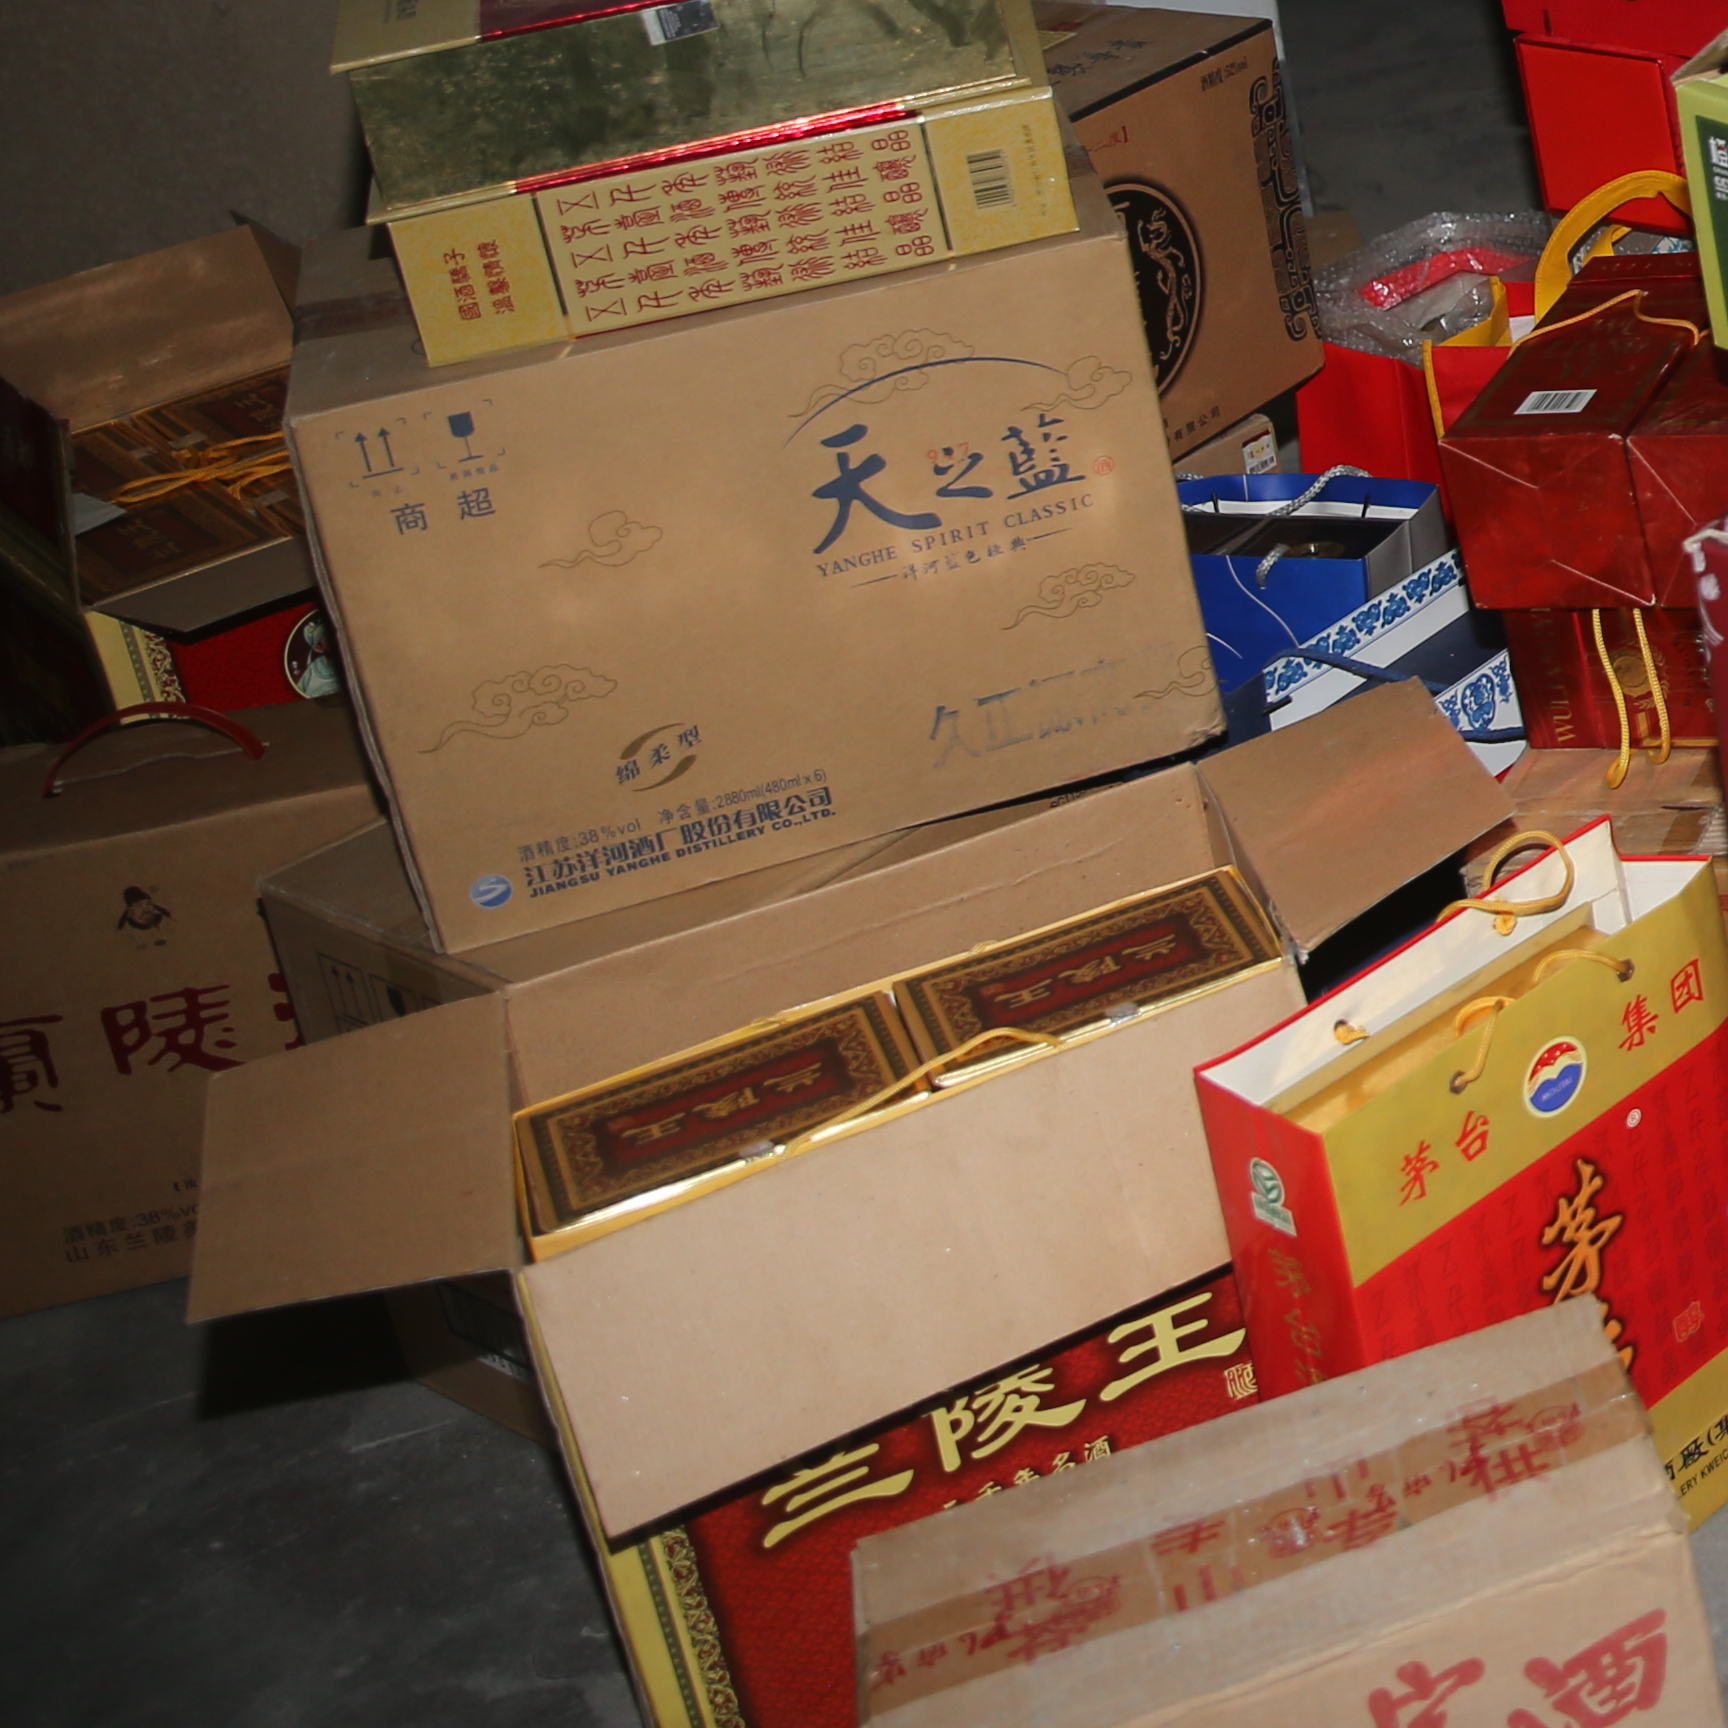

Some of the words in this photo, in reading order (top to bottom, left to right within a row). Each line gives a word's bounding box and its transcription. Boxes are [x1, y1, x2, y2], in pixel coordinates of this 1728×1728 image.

[1168, 405, 1221, 442] 有限公司
[390, 487, 497, 535] 商超
[817, 545, 897, 576] YANGHE
[911, 521, 990, 553] SPIRIT
[1003, 494, 1094, 528] CLASSIC
[523, 786, 834, 888] 江苏洋河酒厂股份有限公司
[530, 872, 600, 900] JIANGSU
[607, 850, 672, 878] YANGHE
[677, 825, 766, 858] DISTILLERY
[1399, 1110, 1490, 1206] 茅台
[1619, 958, 1704, 1052] 集团
[762, 1291, 1247, 1549] 兰陵王
